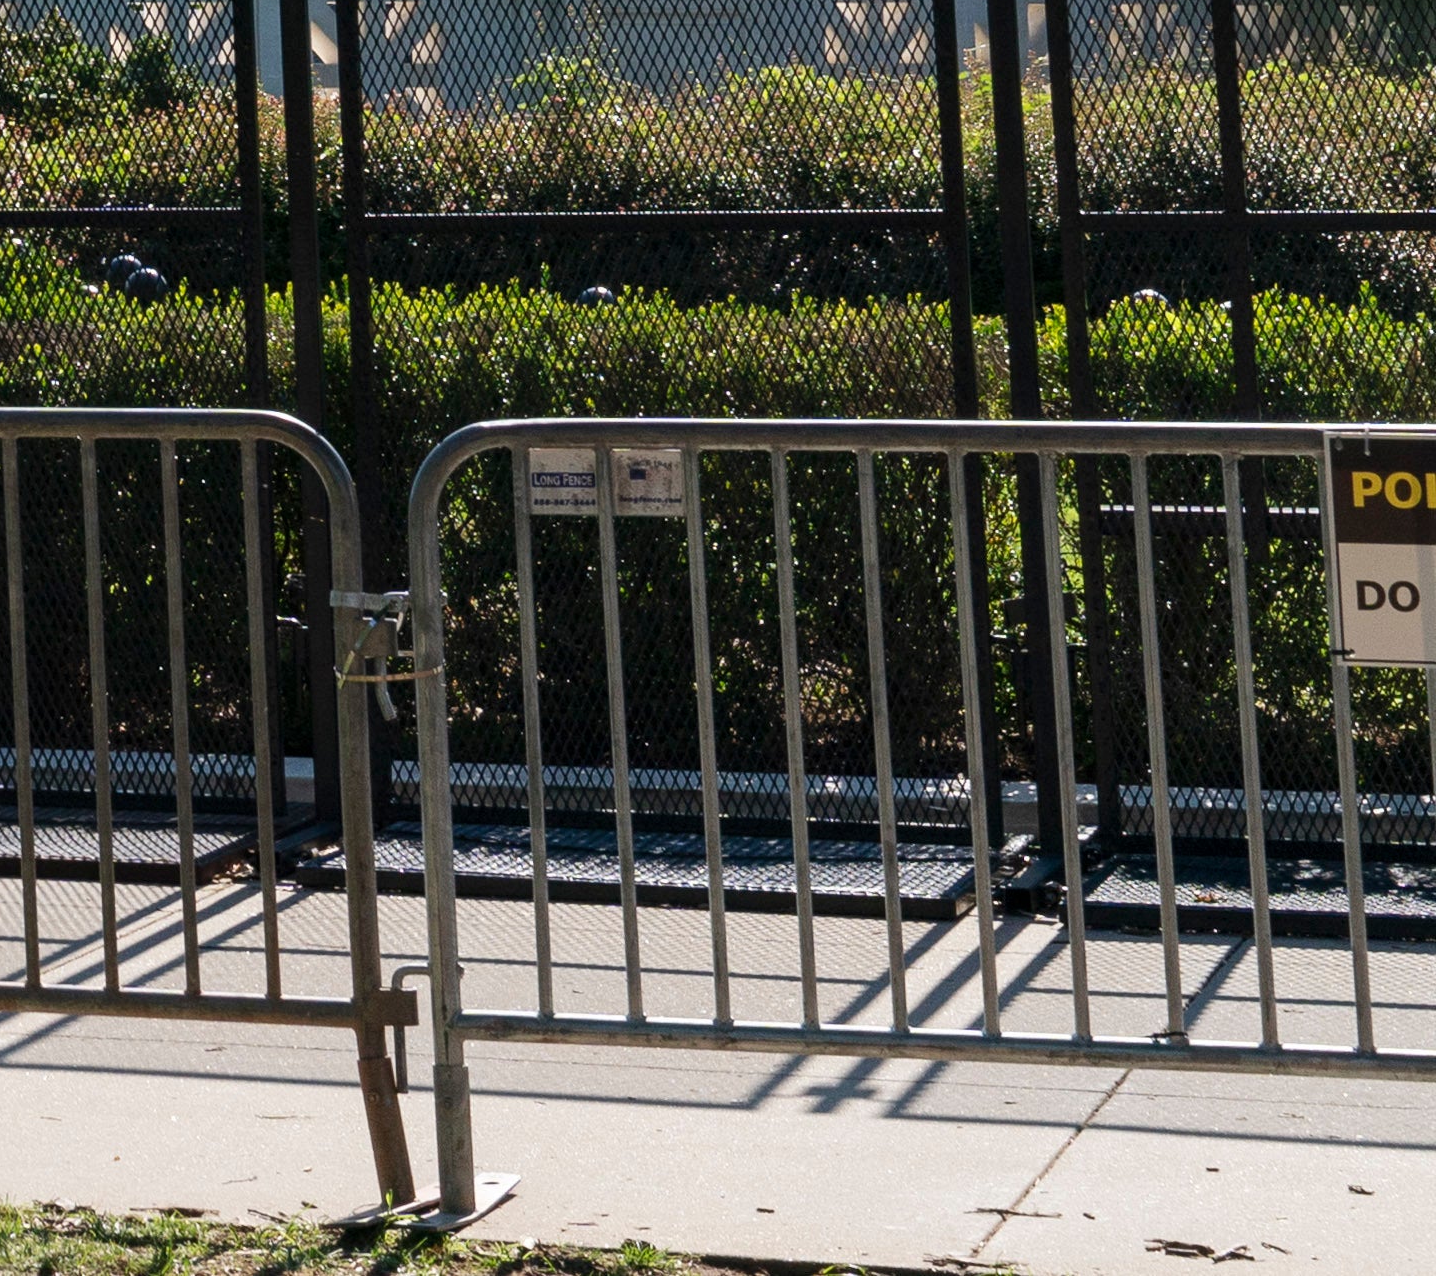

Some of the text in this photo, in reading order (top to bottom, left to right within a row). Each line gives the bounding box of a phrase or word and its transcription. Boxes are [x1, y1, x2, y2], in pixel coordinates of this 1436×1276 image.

[533, 473, 593, 486] LONG FENCE
[1355, 579, 1421, 613] DO
